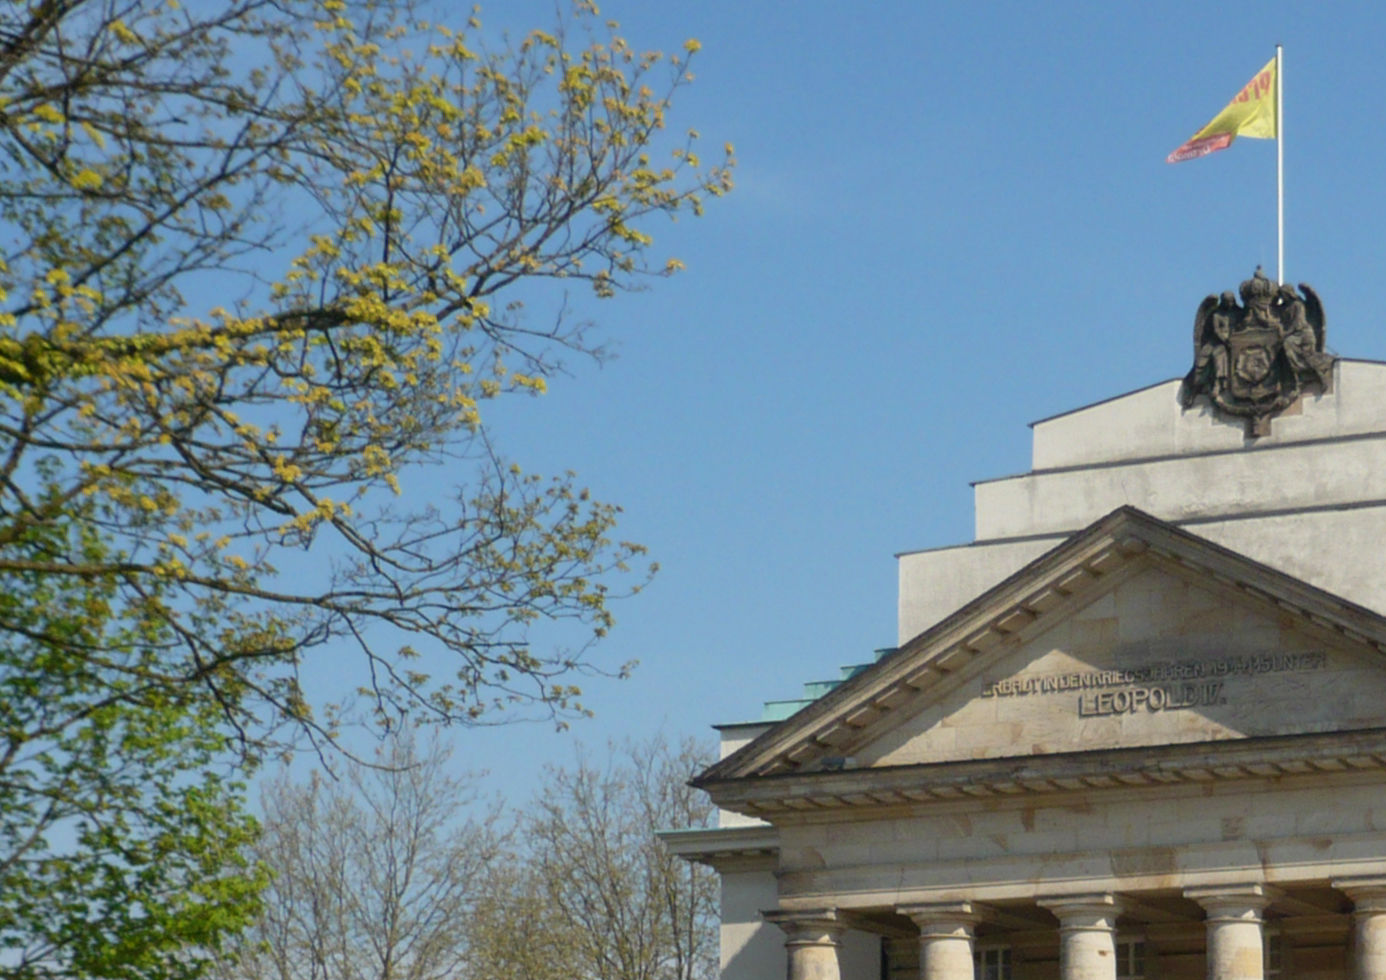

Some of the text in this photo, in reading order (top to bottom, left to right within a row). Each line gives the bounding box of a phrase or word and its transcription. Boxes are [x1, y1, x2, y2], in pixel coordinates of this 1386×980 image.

[980, 676, 1039, 699] ERBAUT
[1041, 675, 1058, 693] IN
[1059, 671, 1091, 692] DEN
[1079, 681, 1228, 719] LEOPOLD IV.
